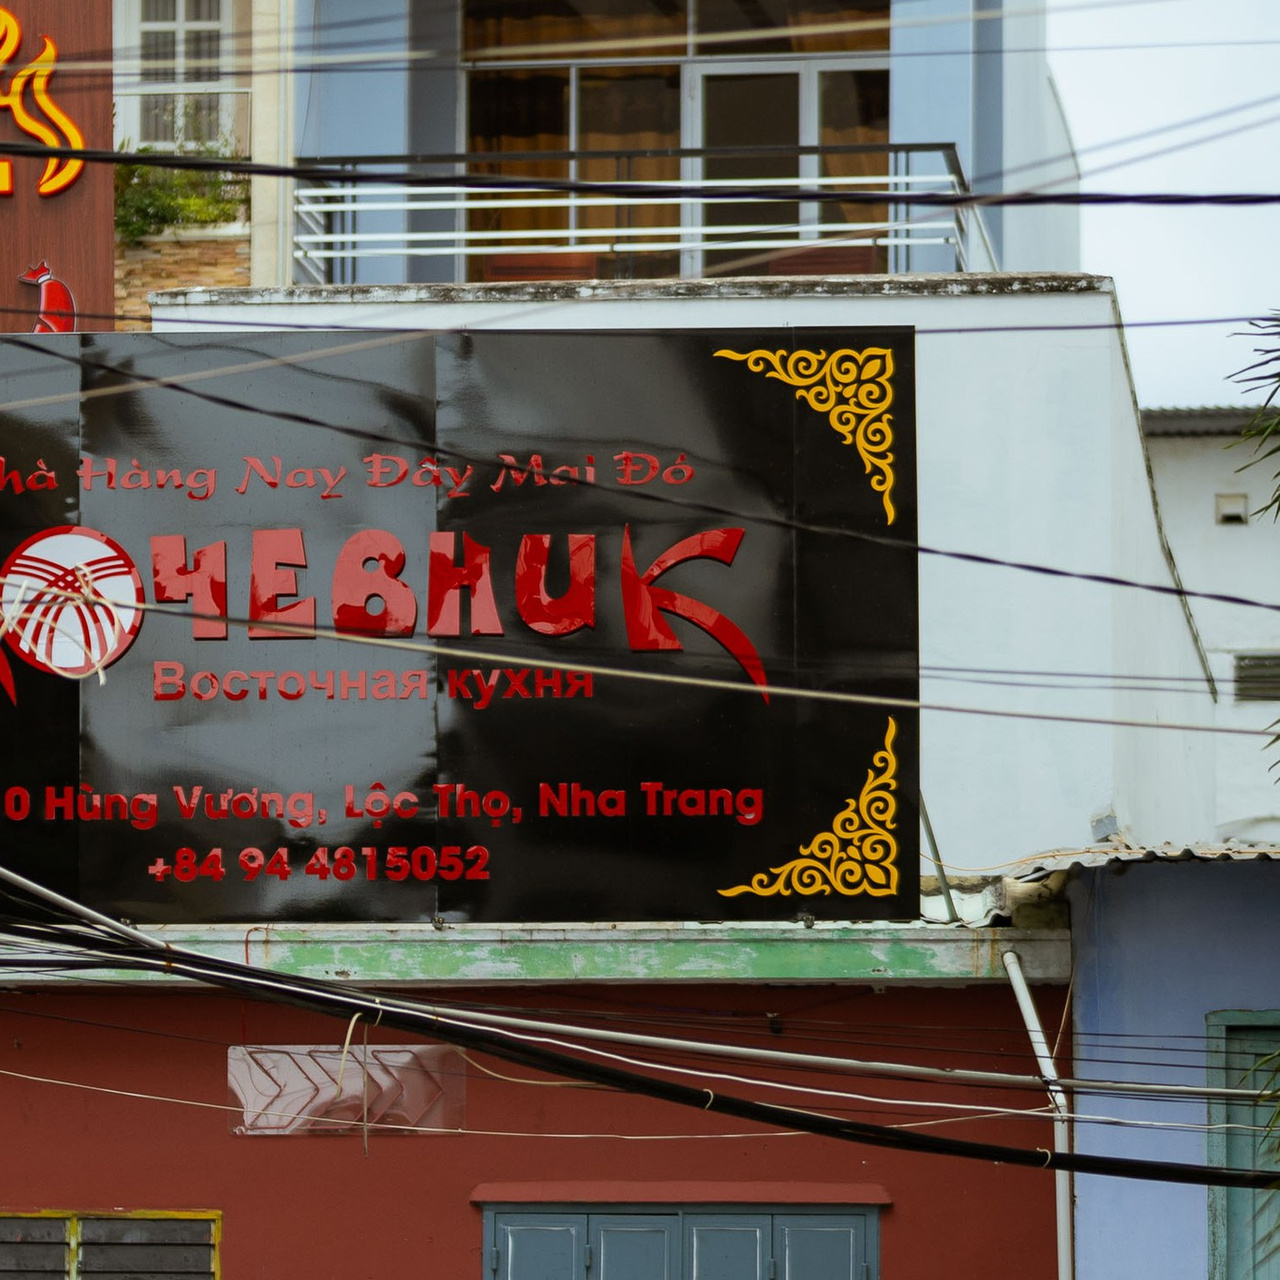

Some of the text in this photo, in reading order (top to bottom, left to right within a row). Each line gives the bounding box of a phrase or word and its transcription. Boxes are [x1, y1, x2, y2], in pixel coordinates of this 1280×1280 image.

[77, 454, 217, 499] Hàng
[235, 456, 347, 499] Nay
[362, 453, 473, 499] Đây
[490, 454, 595, 491] Mai
[615, 451, 695, 485] Đó
[152, 660, 594, 707] Восточная кухня
[45, 784, 159, 830] Hùng
[173, 784, 326, 829] Vương,
[346, 783, 417, 831] Lộc
[437, 784, 522, 829] Thọ,
[539, 782, 626, 817] Nha
[642, 783, 764, 826] Trang
[148, 845, 491, 882] +84 94 4815052
